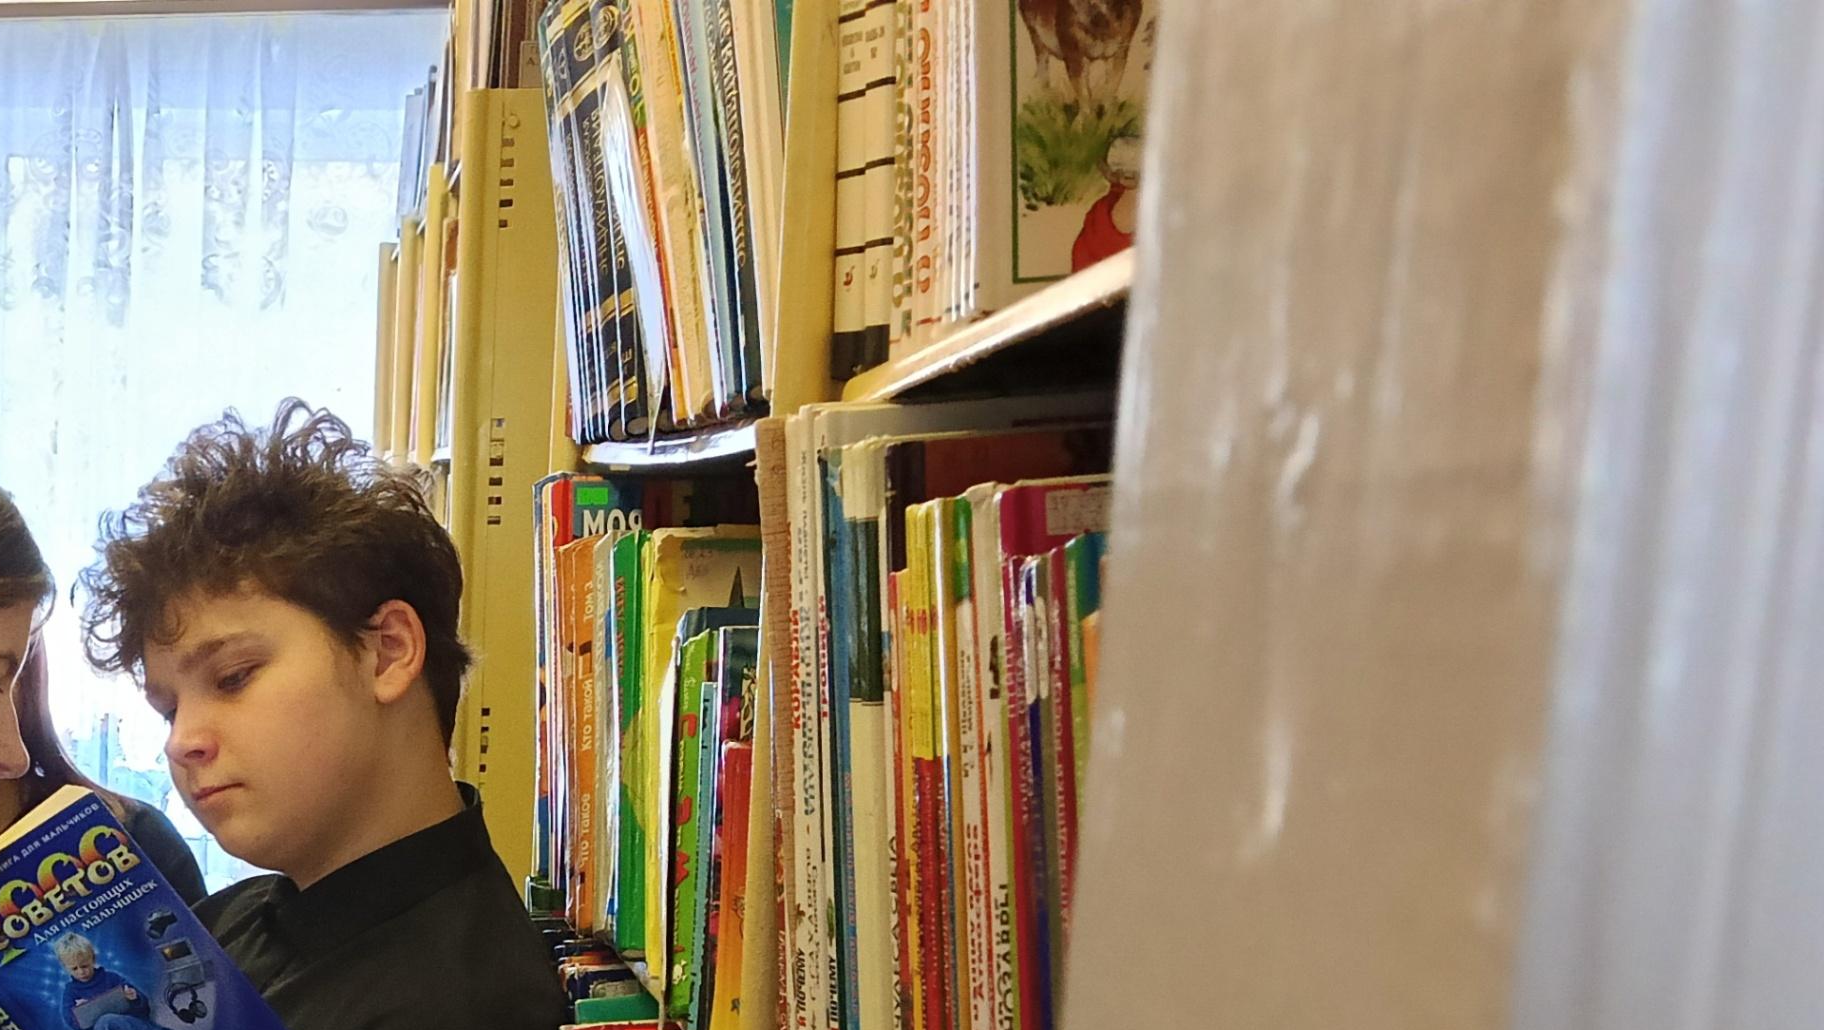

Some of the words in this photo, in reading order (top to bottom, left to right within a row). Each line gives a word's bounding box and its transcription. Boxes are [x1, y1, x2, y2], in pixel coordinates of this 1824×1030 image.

[789, 608, 801, 730] КОРАБЛИ
[580, 678, 593, 720] такой
[579, 723, 592, 751] Кто
[21, 841, 42, 858] ДЛЯ
[42, 802, 101, 844] МАЛЬЧИКОВ
[60, 876, 135, 928] настоящих
[80, 878, 159, 932] мальчишек
[795, 947, 808, 1013] ПОЧЕМУ
[827, 954, 839, 1024] ПОЧЕМУ
